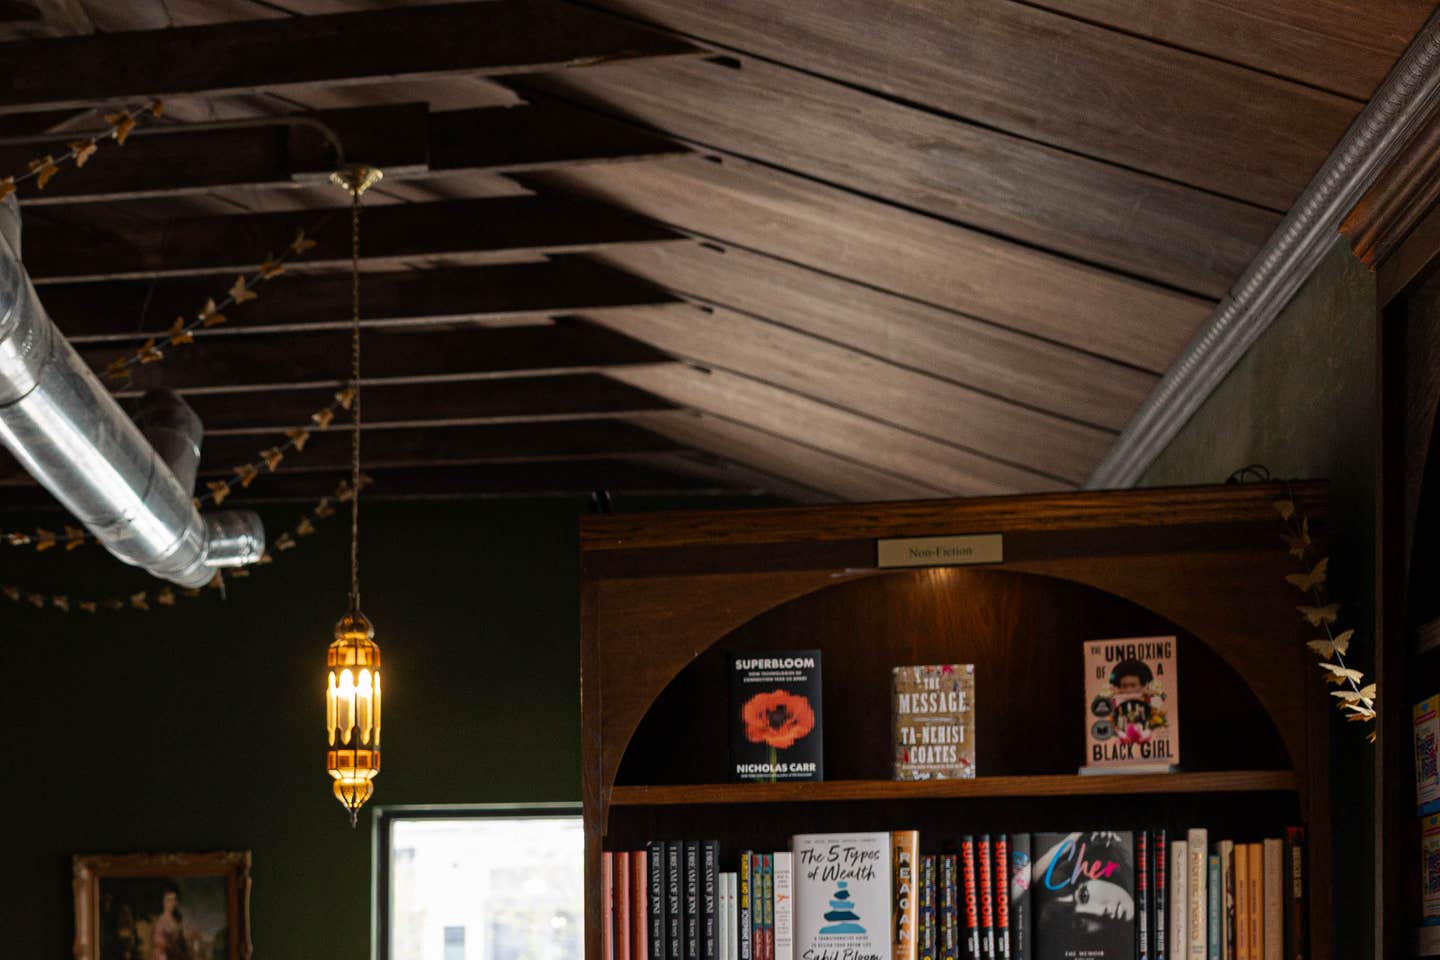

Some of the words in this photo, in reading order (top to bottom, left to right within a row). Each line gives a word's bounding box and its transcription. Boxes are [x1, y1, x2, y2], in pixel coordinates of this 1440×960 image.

[910, 546, 973, 558] Non-Fiction
[1105, 642, 1172, 662] UNBOXING
[735, 658, 815, 670] SUPERBLOOM
[1096, 667, 1106, 679] OF
[1157, 663, 1164, 676] A
[924, 678, 940, 689] THE
[898, 692, 966, 714] MESSAGE
[901, 726, 964, 744] TA-NEHISI
[910, 745, 957, 763] COATES
[1093, 744, 1134, 761] BLACK
[1140, 740, 1173, 758] GIRL
[737, 763, 788, 773] NICHOLAS
[790, 763, 816, 772] CARR
[801, 848, 825, 864] The
[827, 845, 840, 860] 5
[844, 847, 880, 864] Types
[808, 867, 819, 880] of
[822, 864, 875, 881] Wealth
[1044, 839, 1120, 891] Cher
[961, 840, 977, 928] SUPERBLOOM
[978, 840, 993, 928] SUPERBLOOM
[994, 840, 1009, 928] SUPERBLOOM
[899, 852, 910, 942] REAGAN
